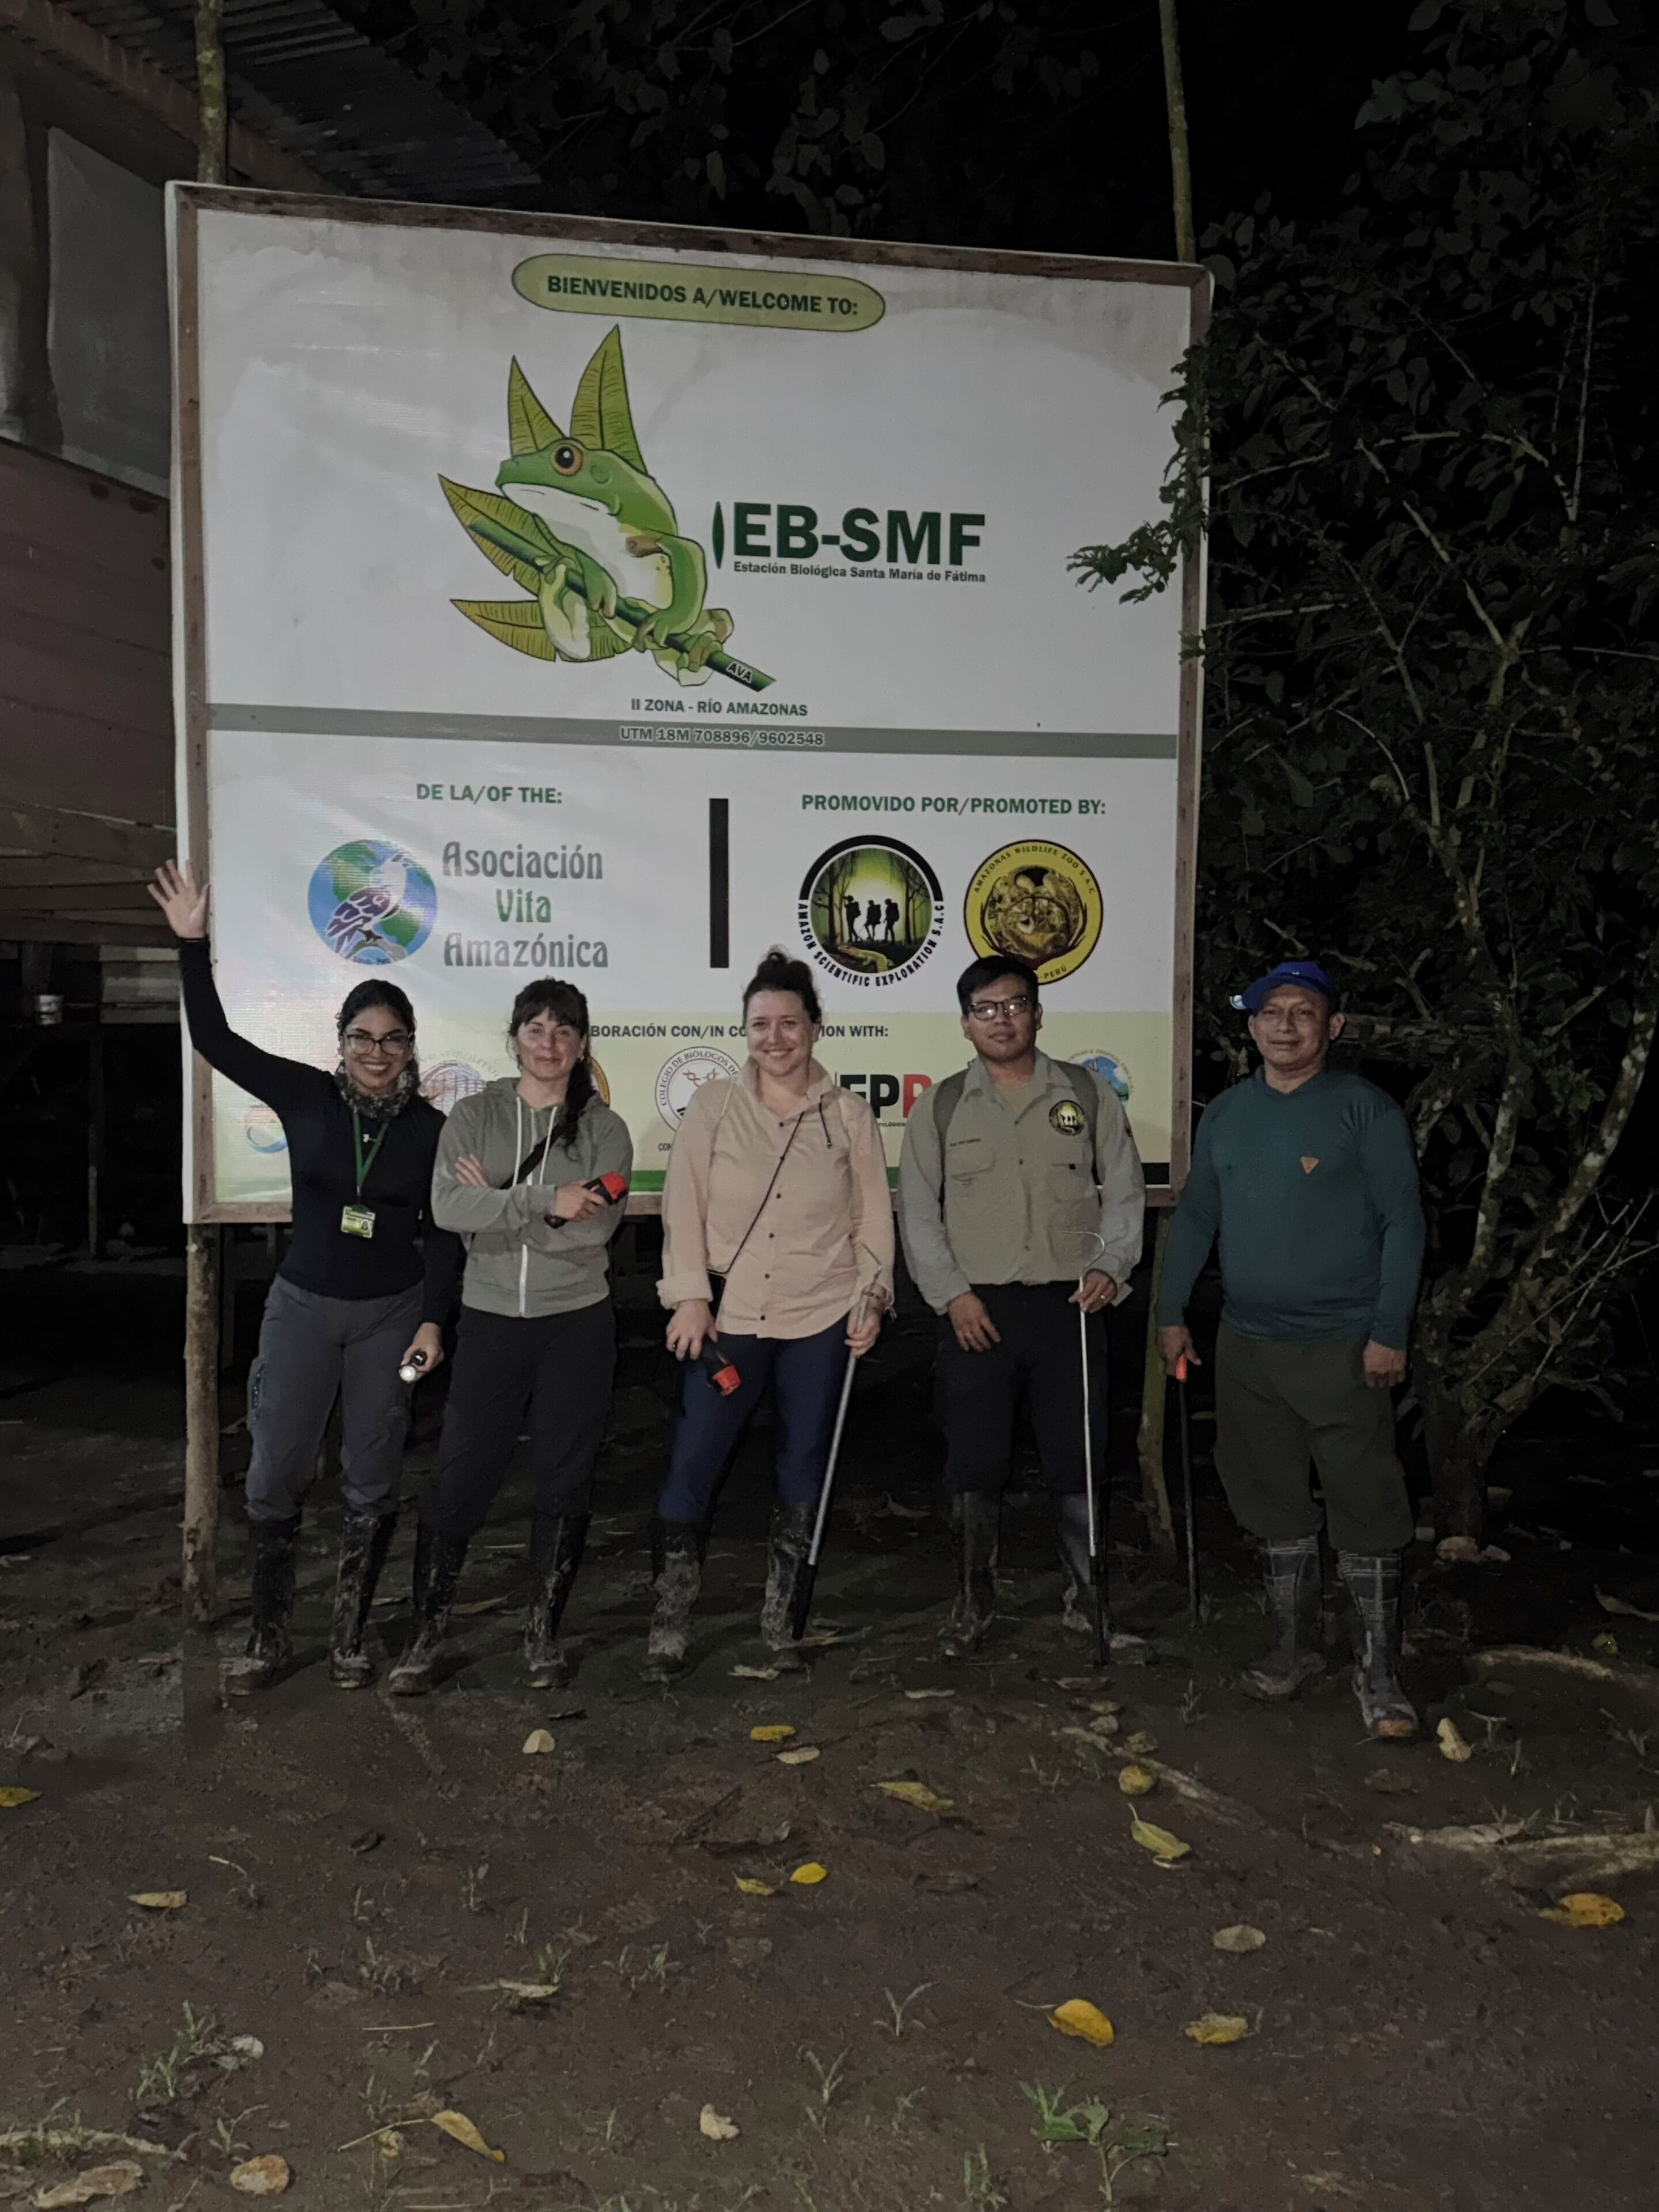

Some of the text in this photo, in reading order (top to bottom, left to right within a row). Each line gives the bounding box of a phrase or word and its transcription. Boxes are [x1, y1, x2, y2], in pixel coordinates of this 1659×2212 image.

[548, 275, 858, 315] BIENVENIDOS A/WELCOME TO:
[734, 502, 986, 566] EB-SMF
[734, 561, 986, 582] Estación Biológica Santa María de Fátima
[728, 662, 752, 682] AVA
[644, 699, 684, 713] ZONA
[697, 698, 722, 714] RÍO
[726, 702, 808, 716] AMAZONAS
[620, 727, 824, 746] UTM 18M 708896/9602548
[416, 783, 562, 804] DE LA/OF THE:
[802, 794, 1106, 816] PROMOVIDO POR/PROMOTED BY:
[442, 840, 603, 880] Asociación
[974, 853, 1012, 893] AMAZONAS
[1014, 845, 1058, 856] WILDLIFE
[1060, 853, 1080, 869] ZOO
[495, 888, 551, 923] Vita
[444, 932, 609, 968] Amazónica
[798, 903, 817, 949] AMAZON
[813, 951, 870, 987] SCIENTIFIC
[876, 939, 937, 987] EXPLORATION
[590, 1022, 666, 1037] BORACIÓN
[671, 1025, 724, 1039] CON/IN
[850, 1025, 889, 1037] WITH:
[659, 1066, 673, 1106] COLEGIO
[672, 1057, 683, 1069] DE
[684, 1050, 729, 1066] BIÓLOGOS
